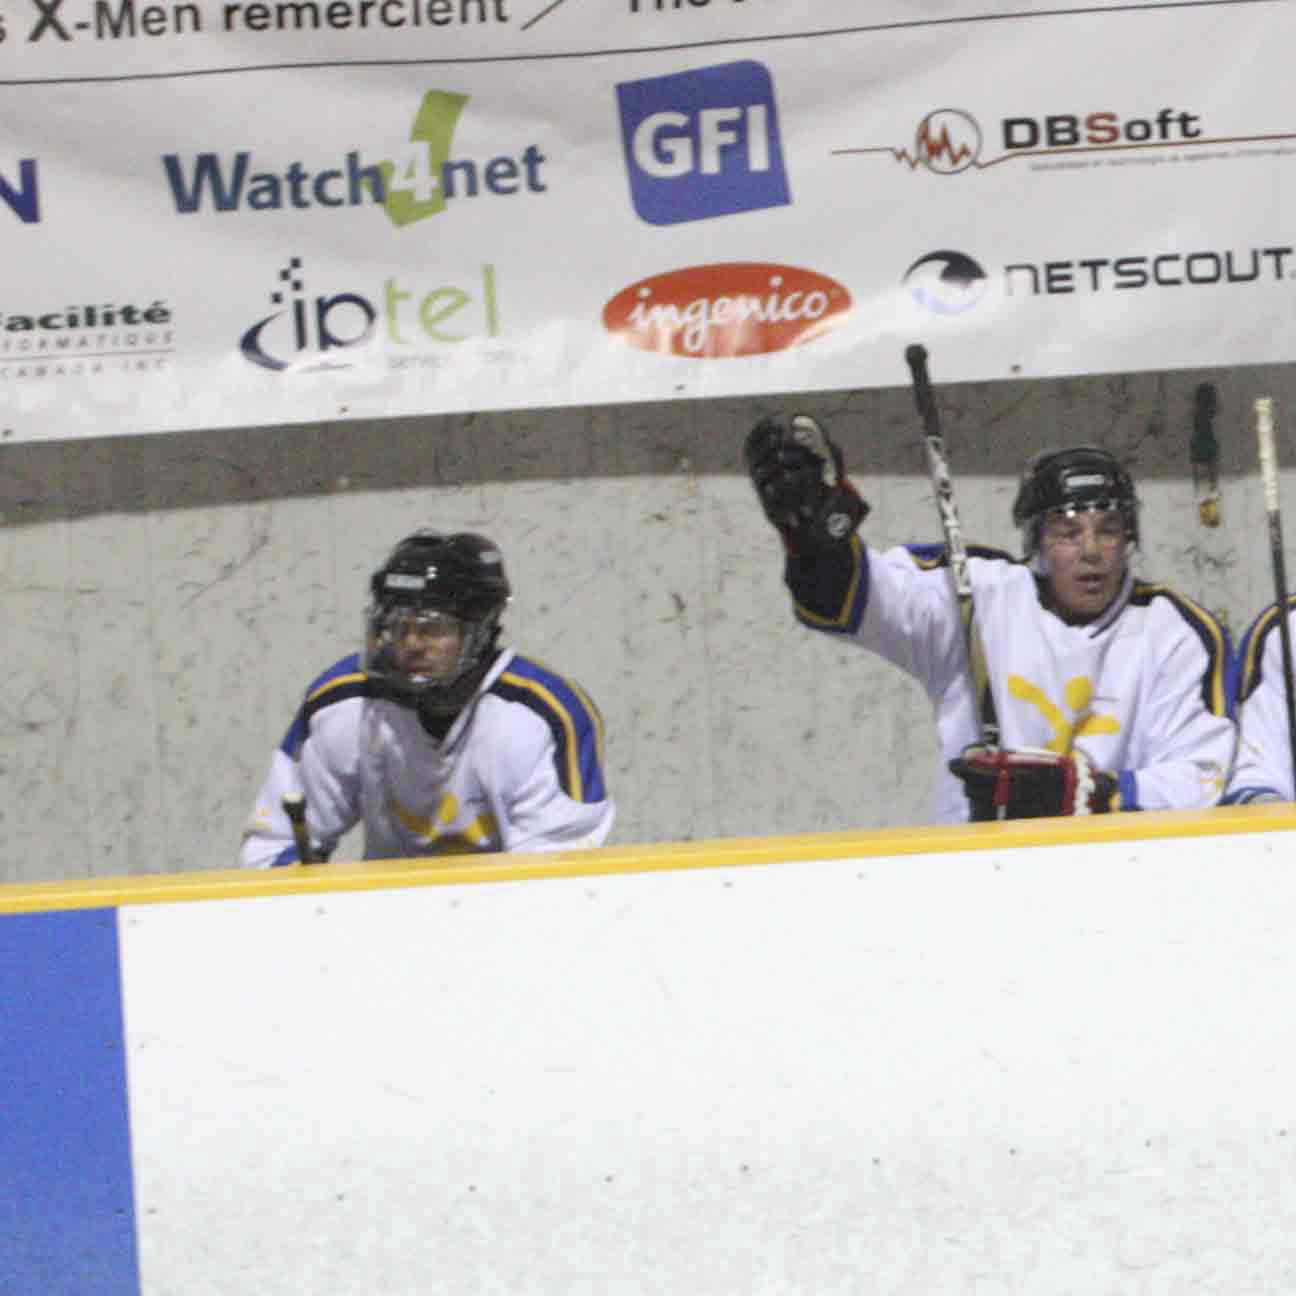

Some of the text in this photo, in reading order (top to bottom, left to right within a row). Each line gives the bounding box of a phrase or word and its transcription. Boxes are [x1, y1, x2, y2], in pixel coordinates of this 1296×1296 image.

[28, 0, 201, 42] X-Men
[223, 0, 509, 33] remercient
[630, 103, 770, 178] GFI
[1002, 109, 1202, 150] DBSoft
[161, 142, 548, 214] Watch4net
[0, 299, 172, 332] acilité
[628, 276, 828, 350] ingenico
